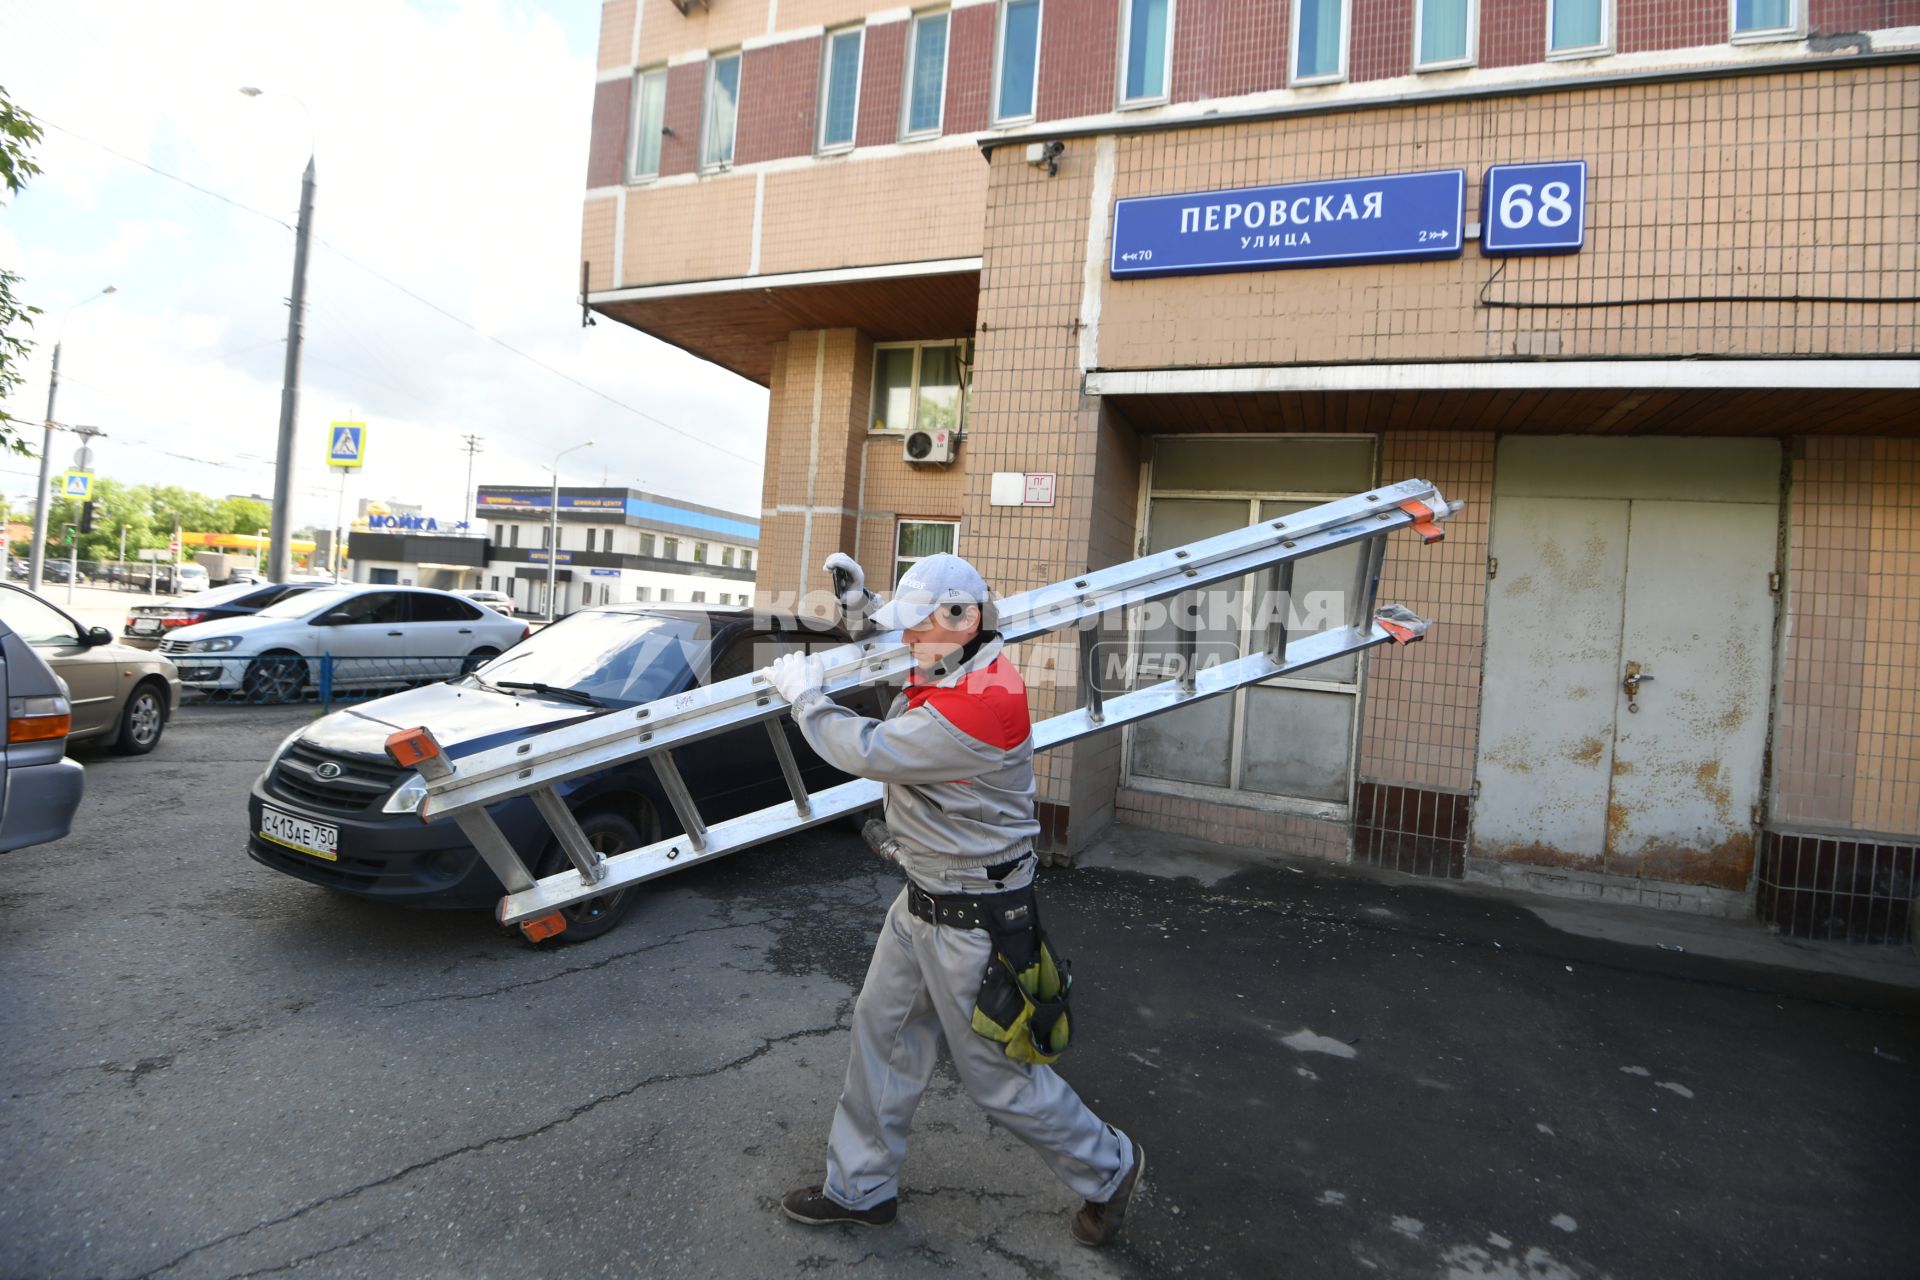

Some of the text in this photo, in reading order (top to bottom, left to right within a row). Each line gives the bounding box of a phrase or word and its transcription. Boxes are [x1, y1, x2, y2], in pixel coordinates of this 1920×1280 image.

[1179, 191, 1383, 234] ПЕРОВСКАЯ
[1499, 181, 1573, 229] 68
[1240, 231, 1312, 249] УЛИЦА
[1418, 230, 1427, 242] 2
[1138, 249, 1153, 261] 70
[1033, 477, 1045, 486] ПГ
[368, 511, 438, 531] МОЙКА
[313, 825, 335, 846] 750
